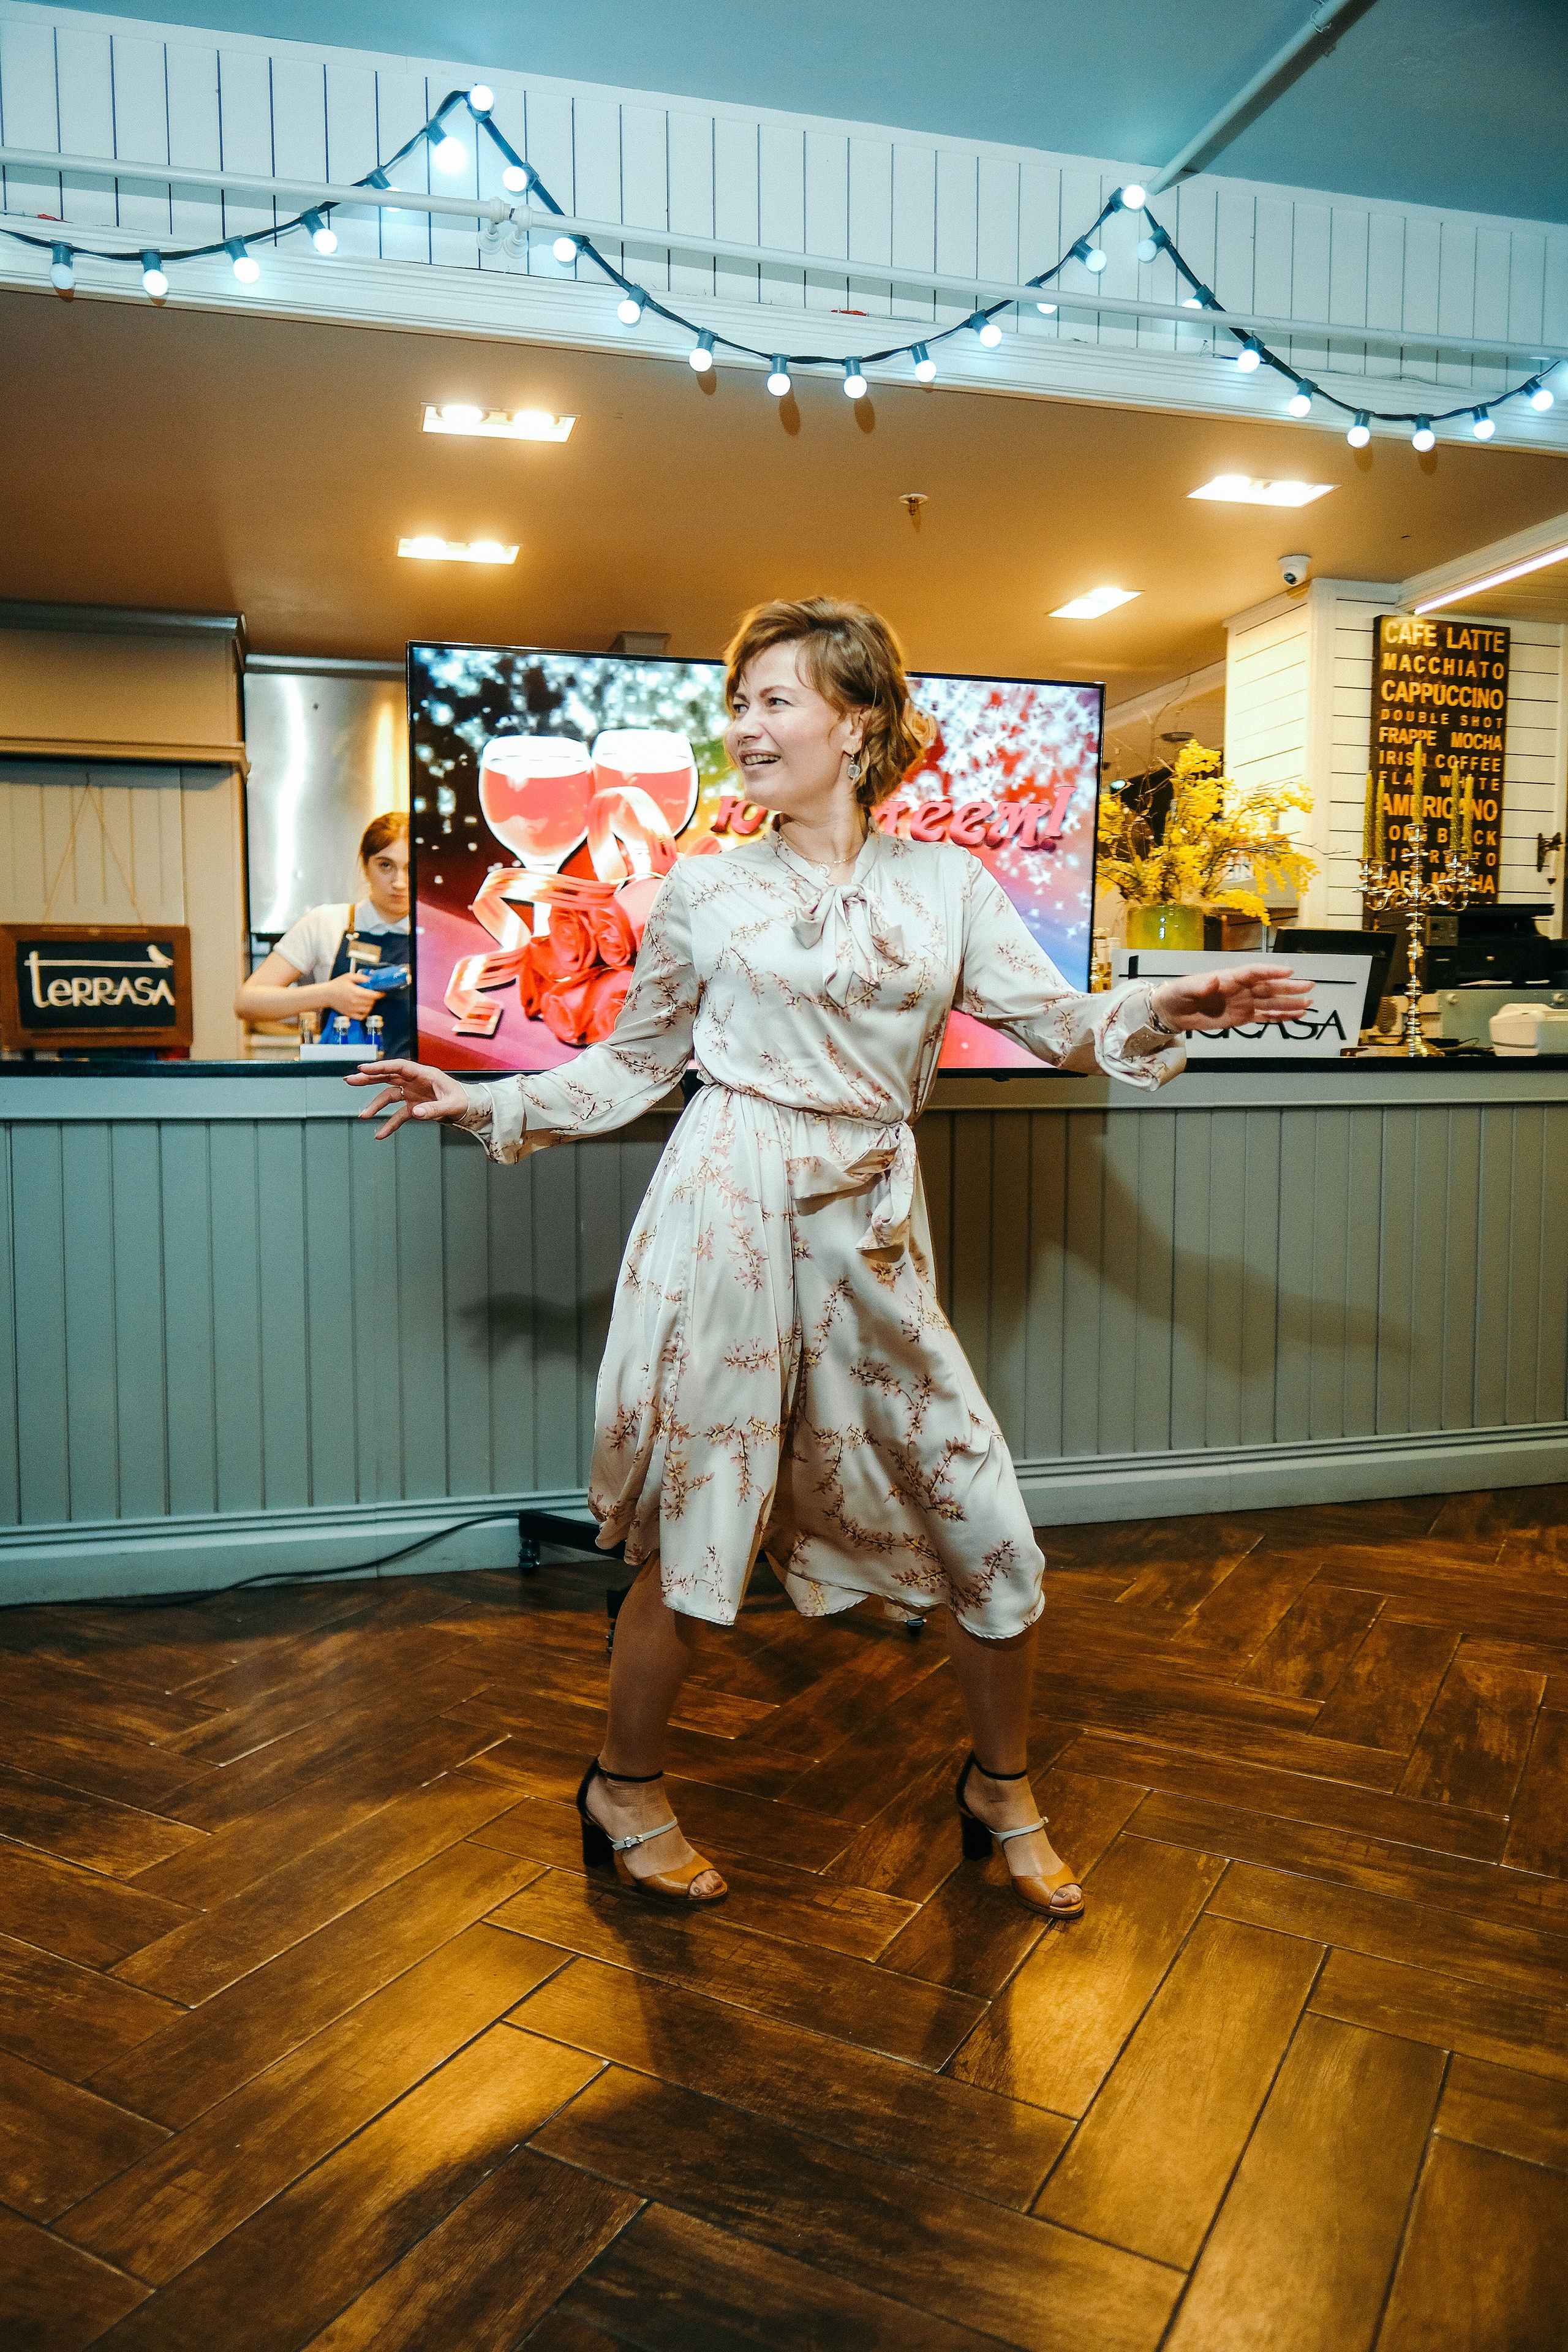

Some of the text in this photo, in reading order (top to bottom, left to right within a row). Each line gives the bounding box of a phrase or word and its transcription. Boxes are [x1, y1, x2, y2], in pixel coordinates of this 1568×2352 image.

[1385, 621, 1506, 654] CAFE LATTE
[1382, 652, 1505, 680] MACCHIATO
[1381, 679, 1504, 710] CAPPUCCINO
[1380, 709, 1503, 729] DOUBLE SHOT
[1379, 726, 1502, 751] FRAPPE MOCHA
[1434, 754, 1501, 772] COFFEE
[1439, 774, 1500, 791] WHTE
[1436, 827, 1497, 846] BCK
